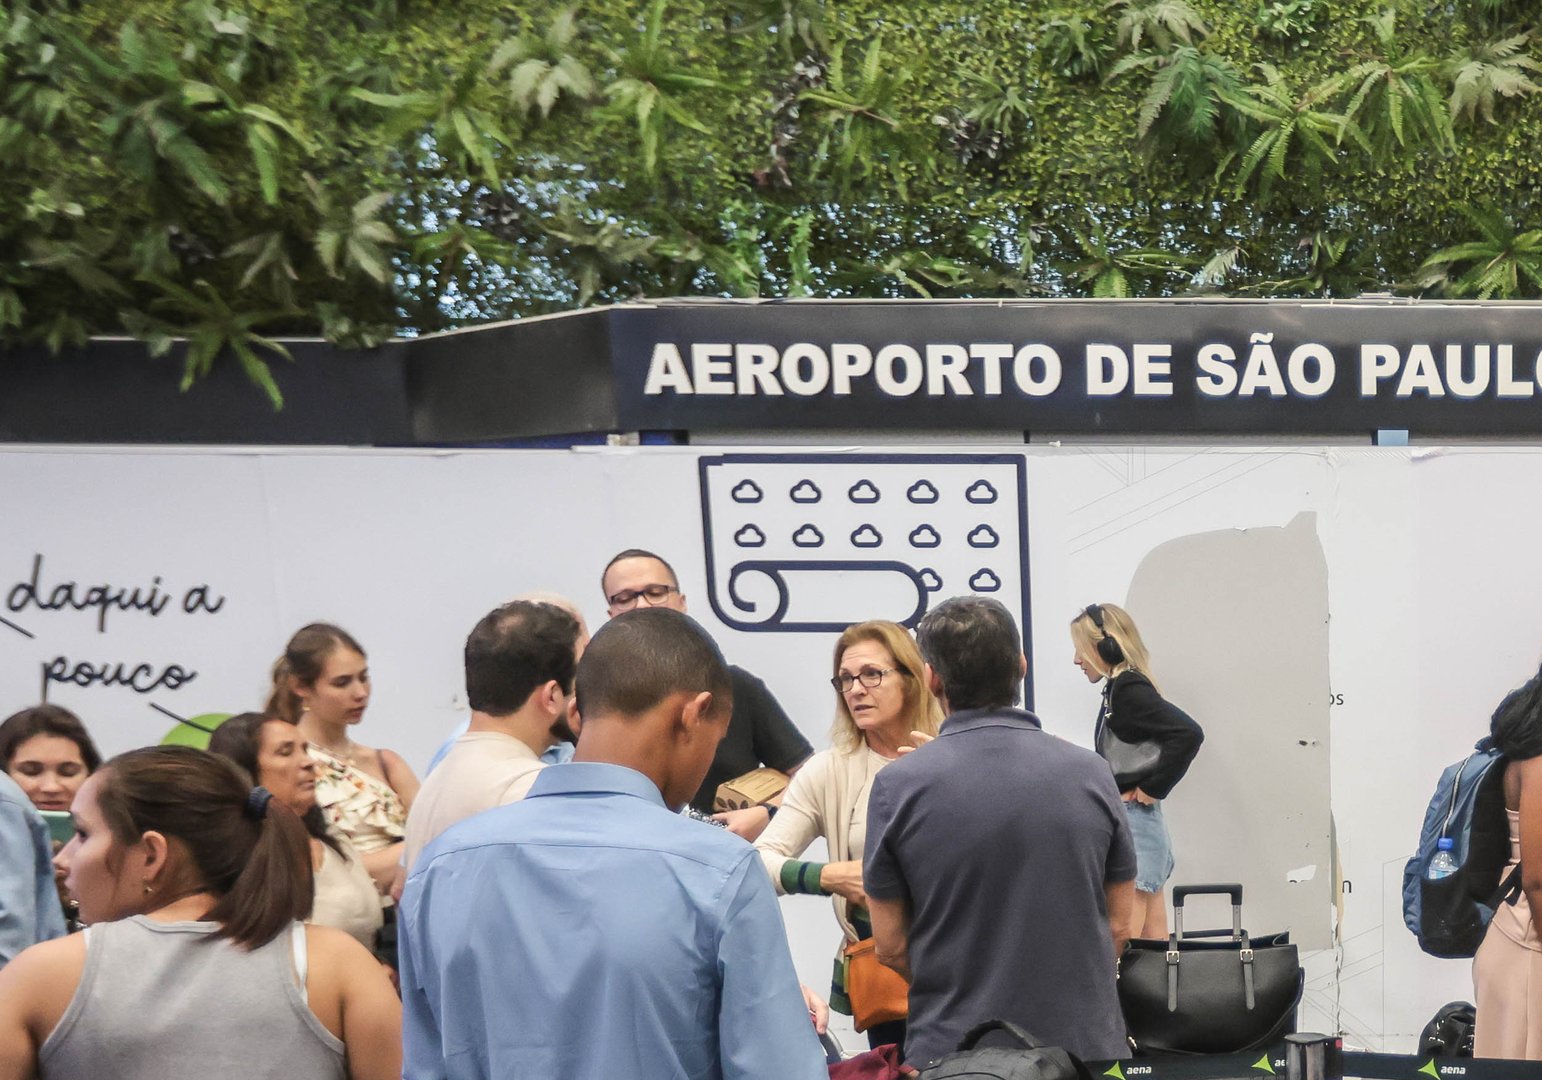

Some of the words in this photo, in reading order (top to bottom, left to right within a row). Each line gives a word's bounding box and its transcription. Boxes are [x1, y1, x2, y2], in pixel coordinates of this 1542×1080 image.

[643, 342, 1062, 397] AEROPORTO
[1086, 343, 1173, 396] DE
[1196, 332, 1335, 397] SÃO
[7, 553, 171, 633] daqui
[182, 584, 225, 614] a
[41, 656, 198, 702] pouco
[1126, 1065, 1153, 1075] aena
[1274, 1058, 1286, 1068] ae
[1440, 1065, 1466, 1075] aena
